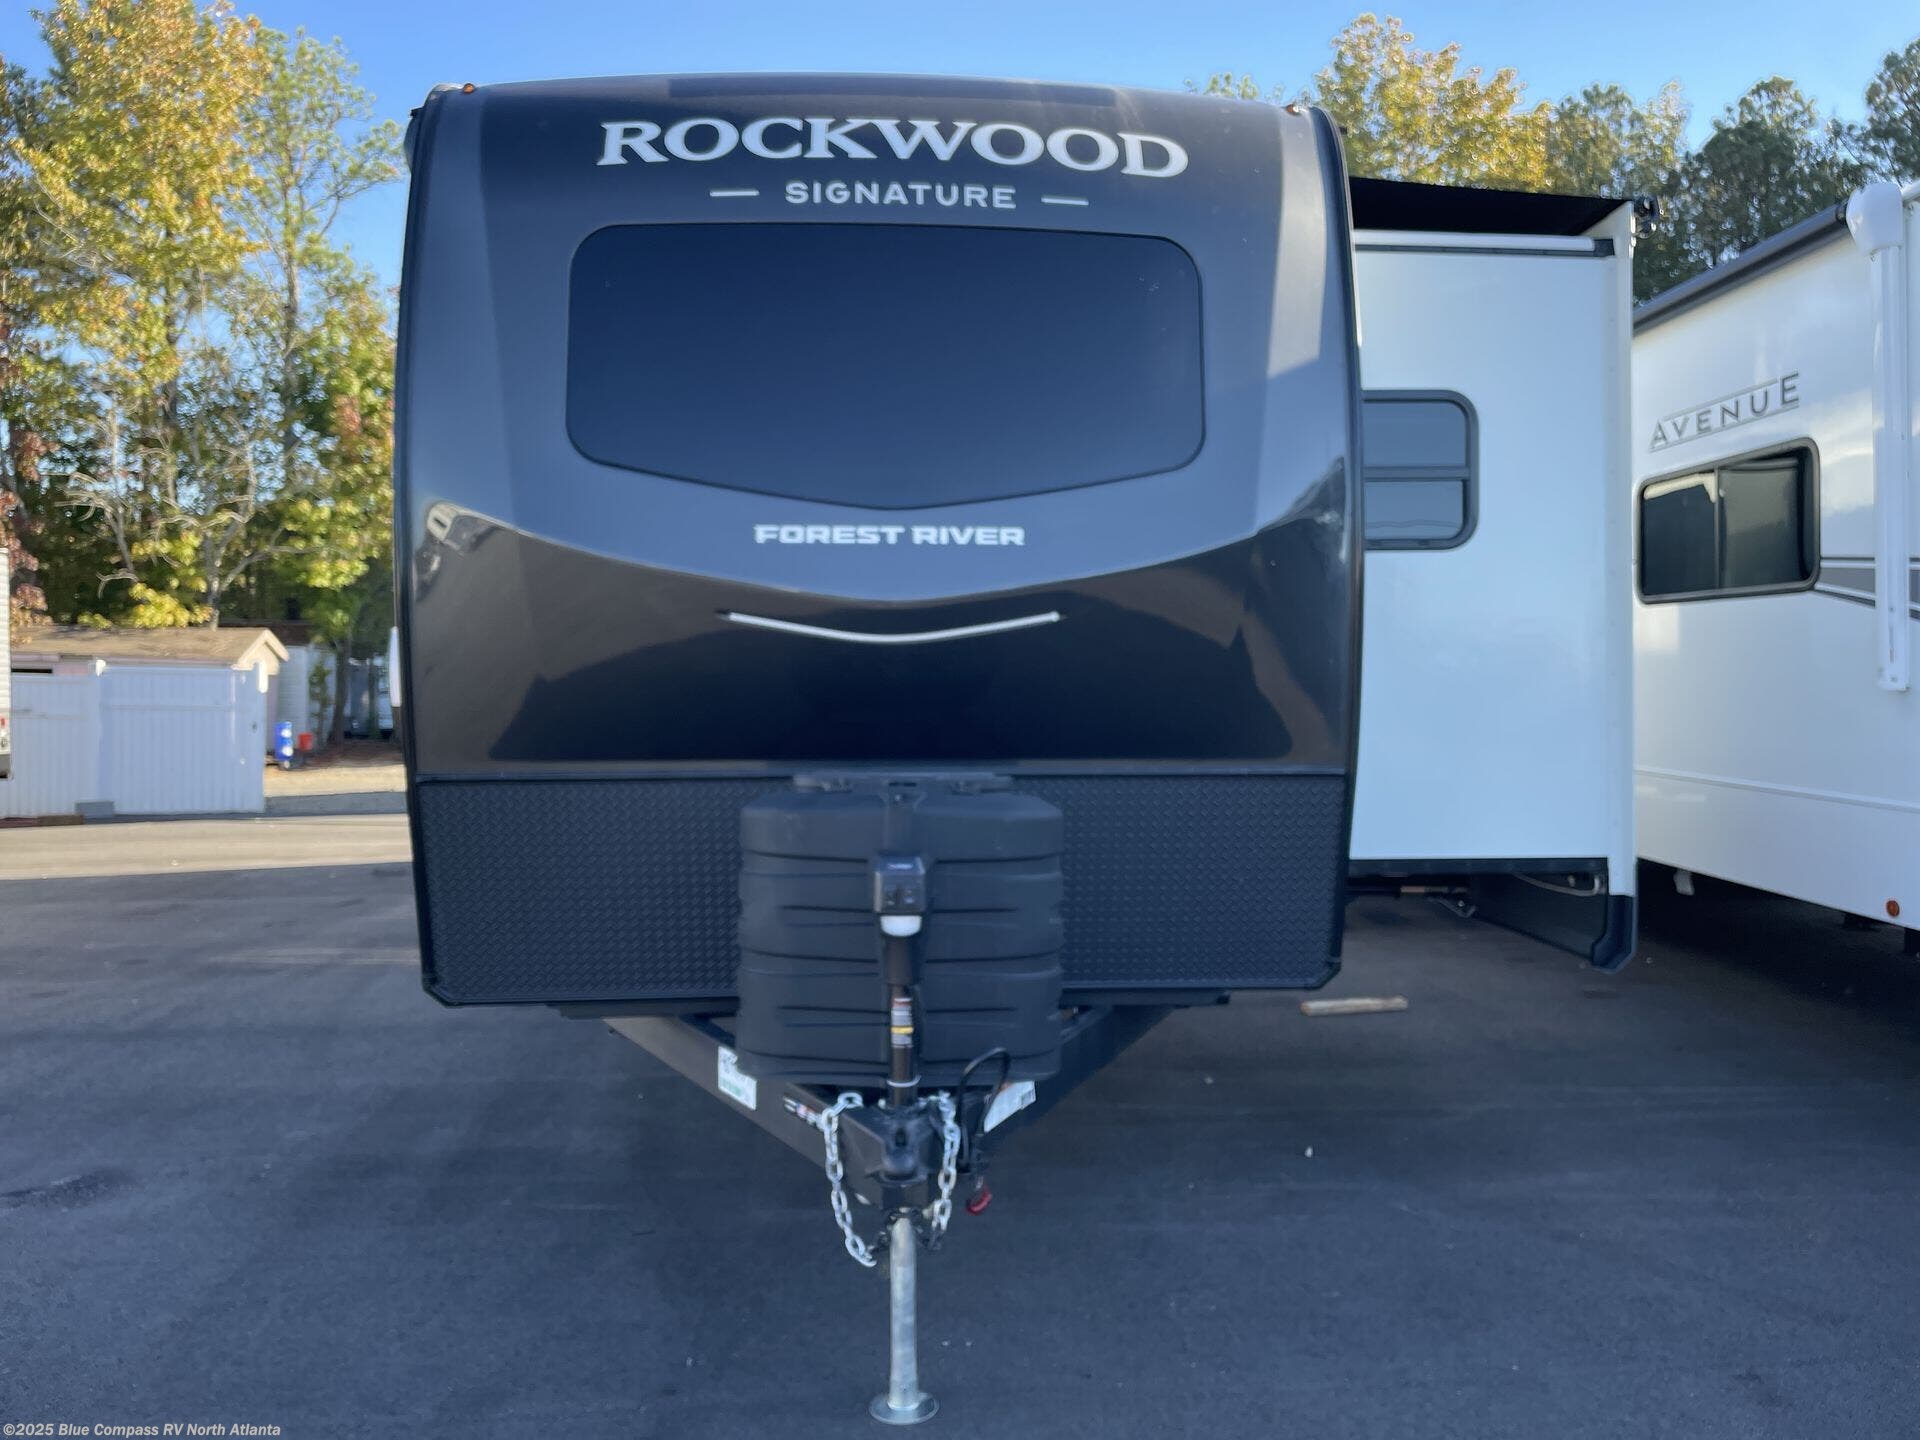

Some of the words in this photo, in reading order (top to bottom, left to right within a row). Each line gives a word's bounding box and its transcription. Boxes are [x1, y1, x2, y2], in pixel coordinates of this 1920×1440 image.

[597, 118, 1189, 178] ROCKWOOD
[785, 181, 1017, 210] SIGNATURE
[1651, 371, 1799, 447] AVENUE
[754, 524, 905, 545] FOREST
[911, 526, 1025, 546] RIVER
